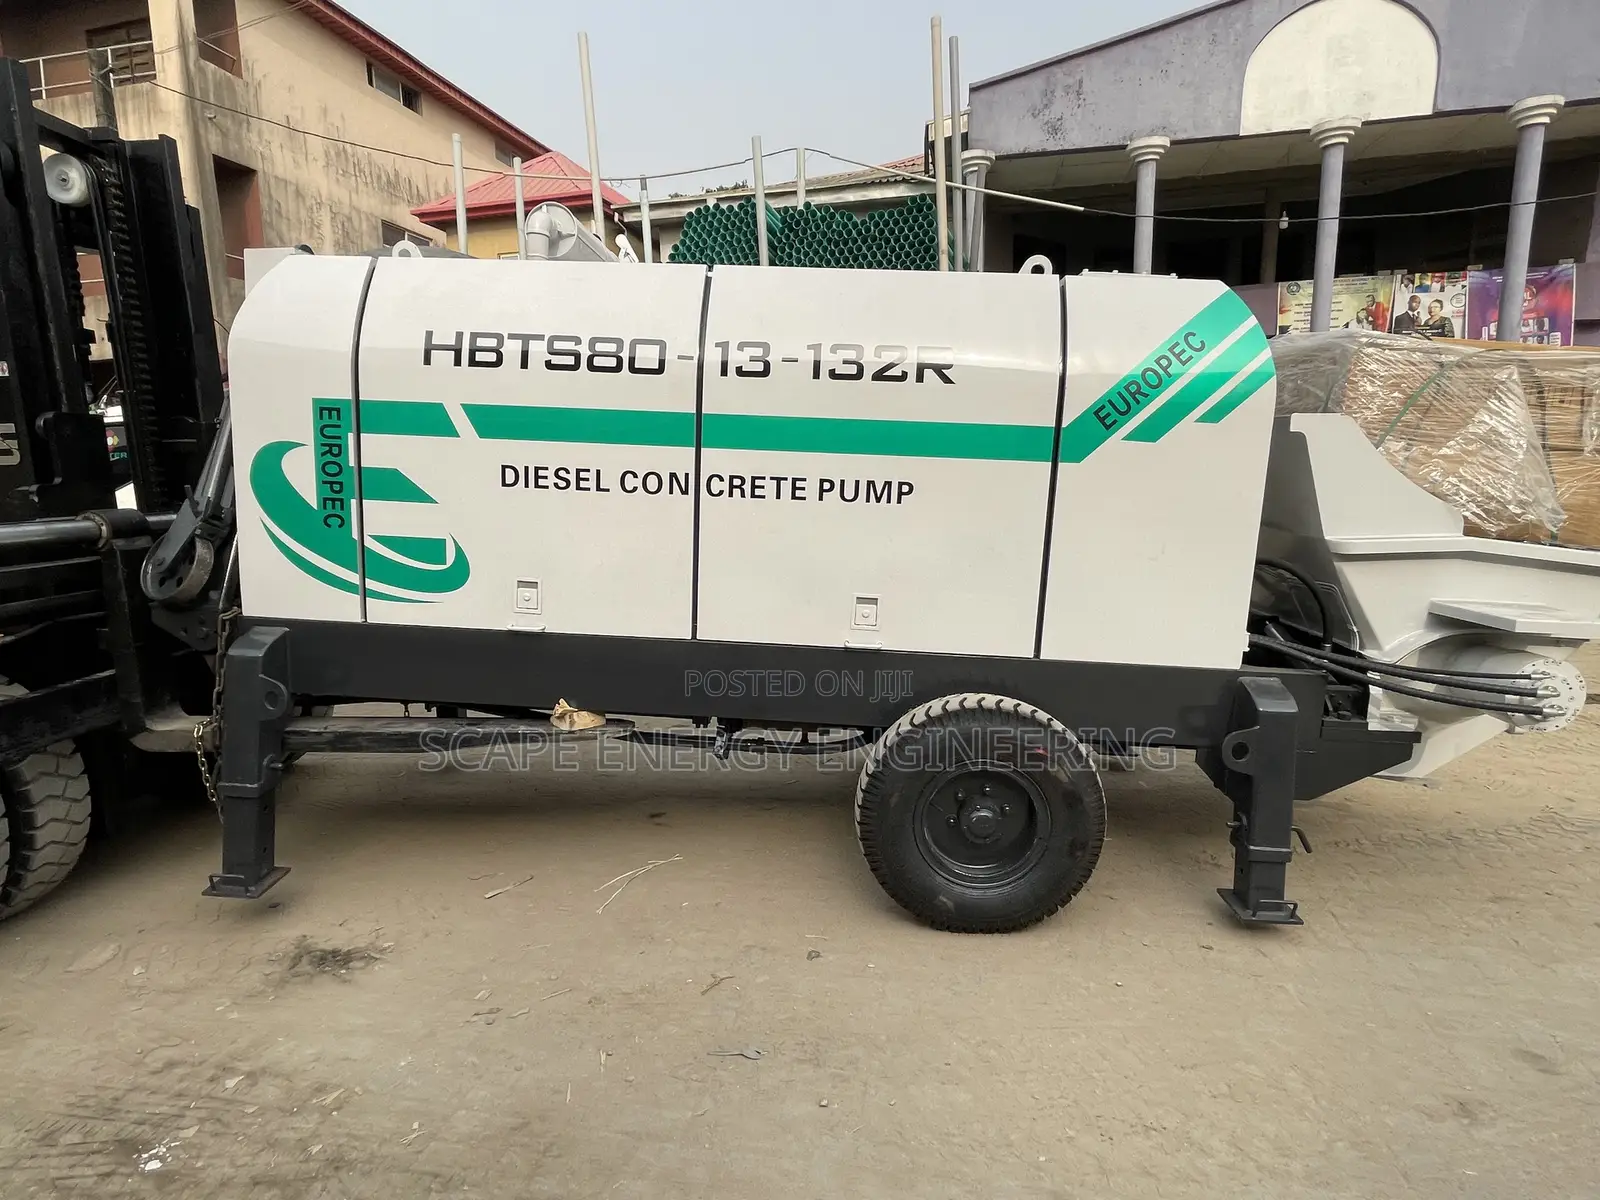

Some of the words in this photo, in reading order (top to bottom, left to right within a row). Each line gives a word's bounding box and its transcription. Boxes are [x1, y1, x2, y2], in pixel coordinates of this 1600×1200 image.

[1092, 331, 1206, 431] EUROPEC
[318, 406, 346, 529] EUROPEC
[500, 464, 611, 493] DIESEL
[818, 478, 914, 505] PUMP
